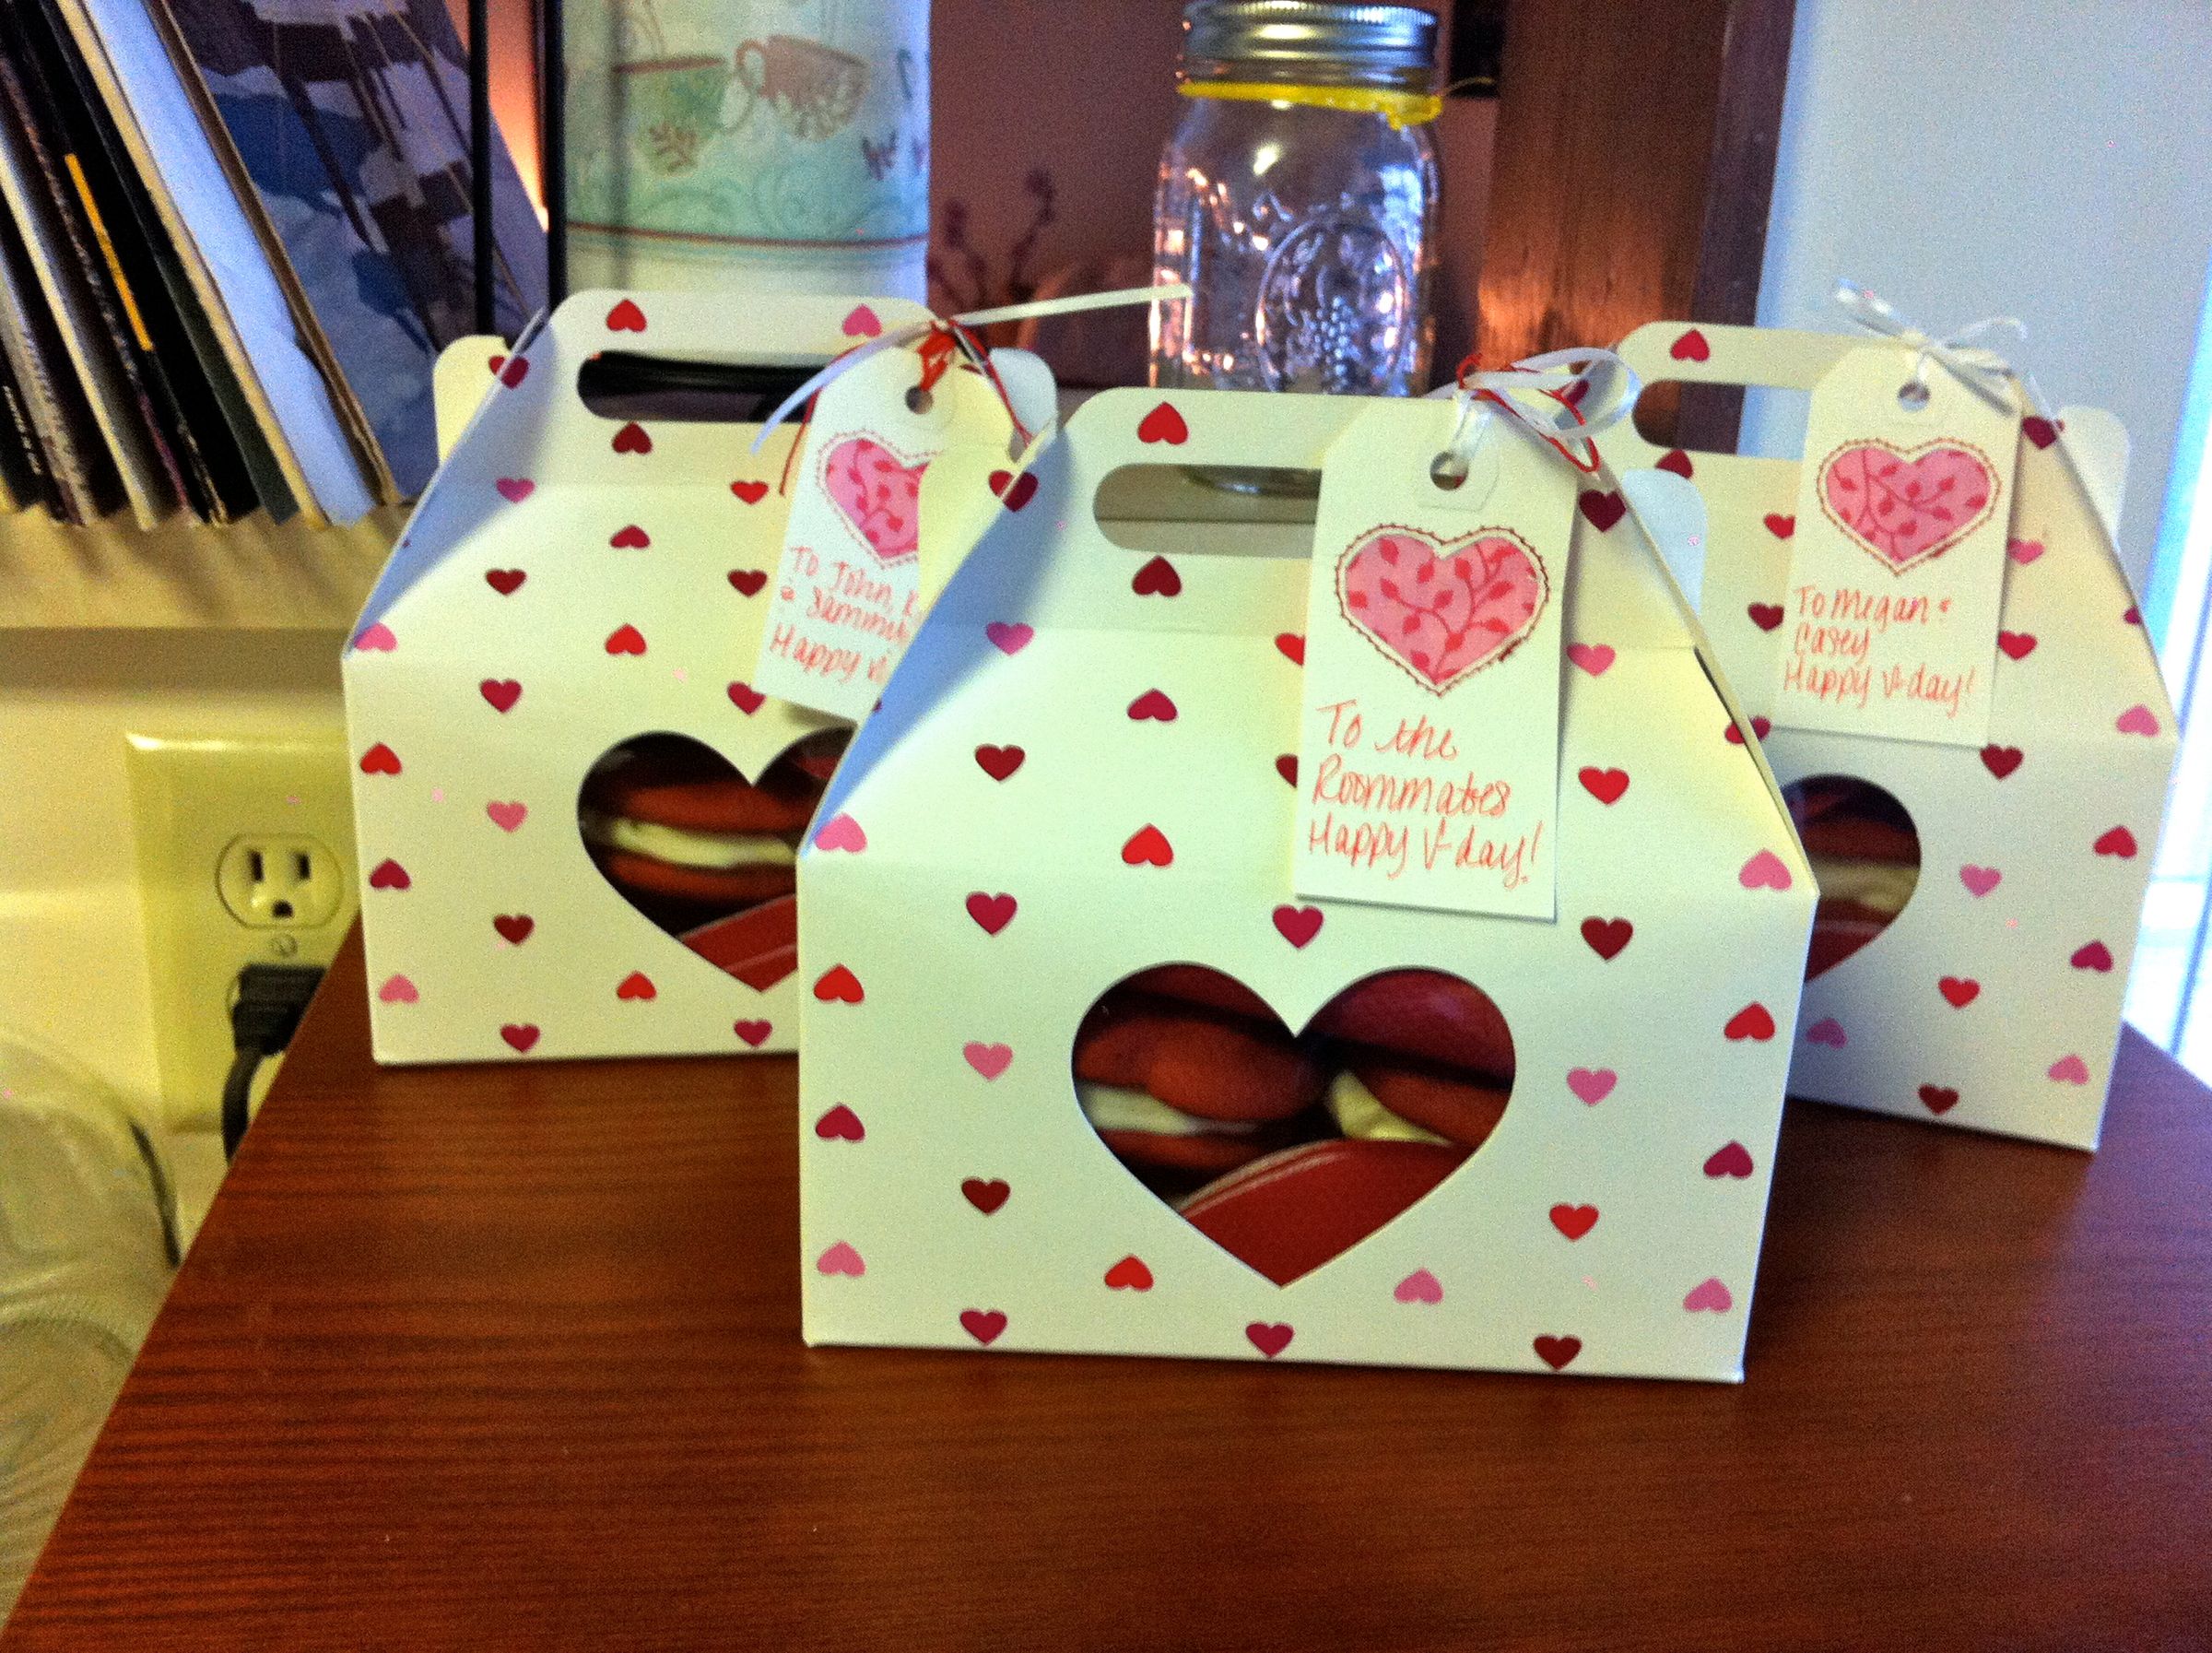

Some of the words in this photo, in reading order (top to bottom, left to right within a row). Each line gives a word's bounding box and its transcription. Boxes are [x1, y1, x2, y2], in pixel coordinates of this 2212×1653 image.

[789, 545, 819, 577] To
[1794, 584, 1827, 619] To
[770, 622, 863, 684] Happy
[1794, 621, 1872, 666] Casey
[1783, 656, 1873, 709] Happy
[1315, 698, 1362, 748] To
[1373, 714, 1459, 761] the
[1312, 752, 1512, 819] Roommates
[1309, 811, 1410, 880] Happy
[1423, 817, 1544, 891] V-day!
